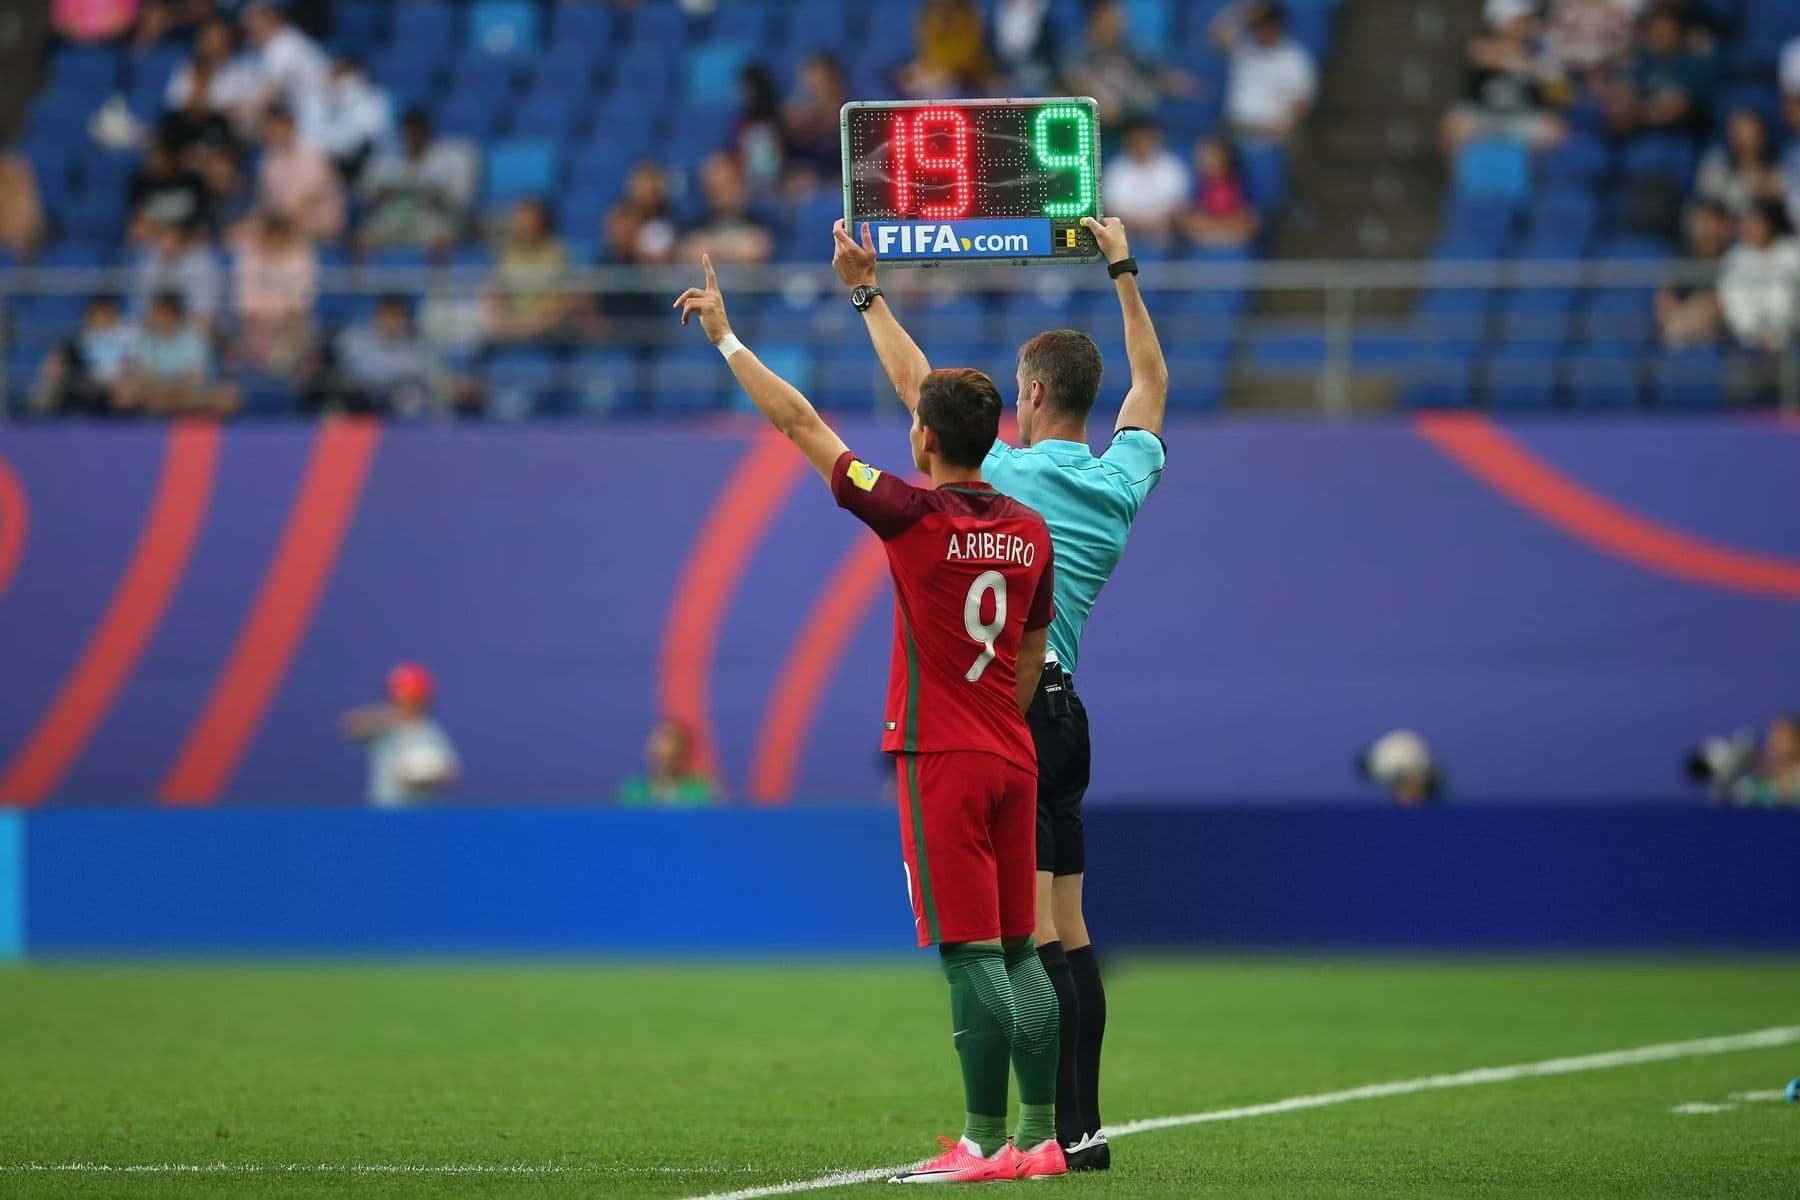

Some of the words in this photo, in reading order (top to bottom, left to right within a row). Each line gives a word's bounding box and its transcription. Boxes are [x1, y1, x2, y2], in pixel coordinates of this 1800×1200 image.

[895, 109, 969, 218] 19
[1035, 106, 1092, 218] 9
[947, 533, 1035, 567] A.RIBEIRO
[964, 571, 1007, 682] 9
